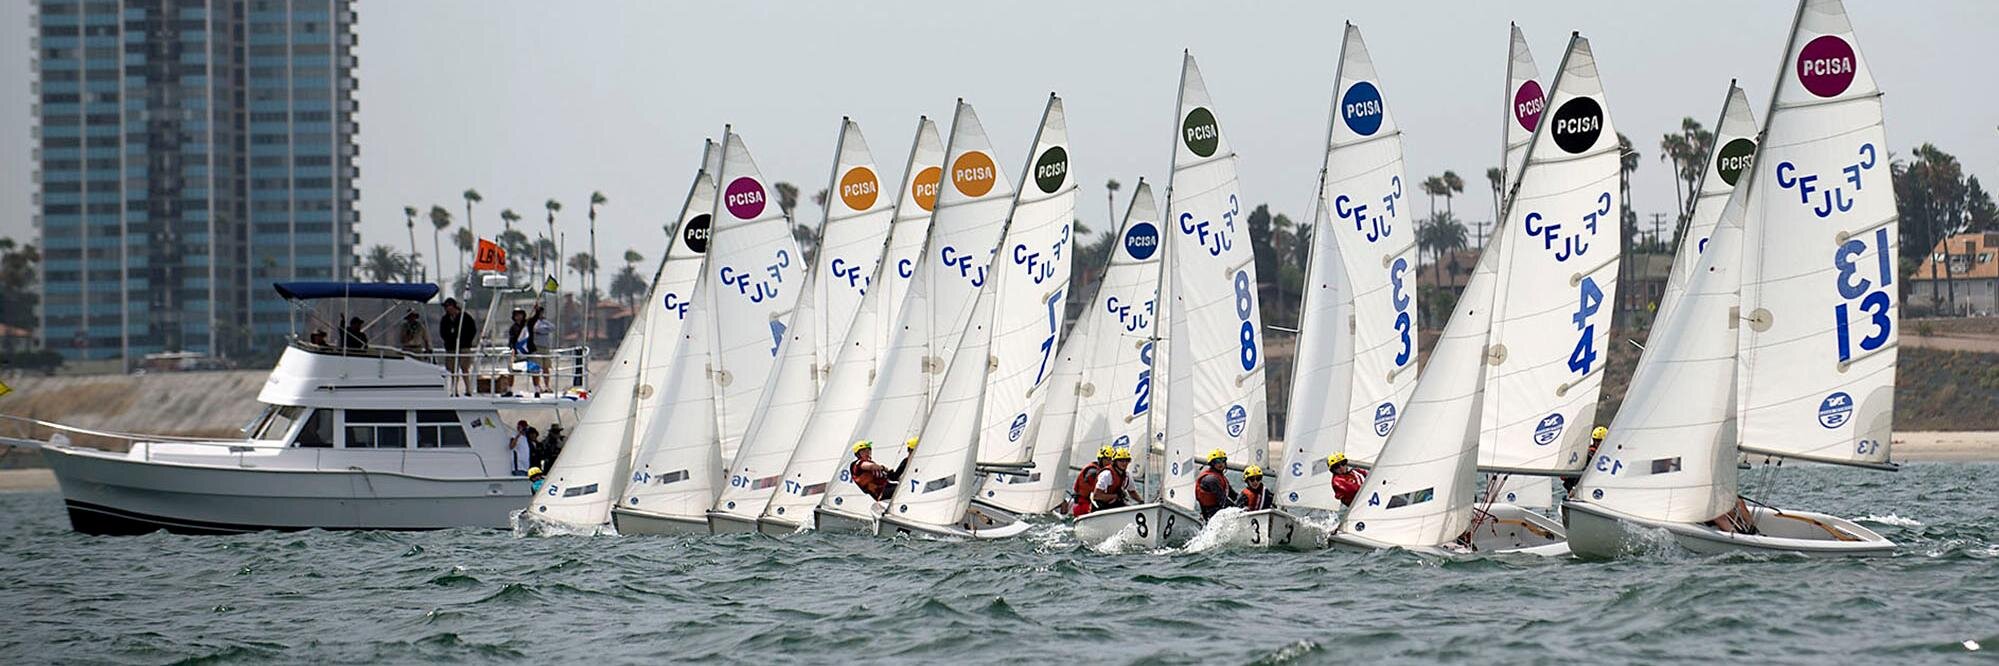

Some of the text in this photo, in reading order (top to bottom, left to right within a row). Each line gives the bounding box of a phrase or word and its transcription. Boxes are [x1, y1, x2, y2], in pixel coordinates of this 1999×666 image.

[1803, 57, 1852, 76] PCISA
[1347, 100, 1381, 118] PCISA
[1518, 97, 1545, 118] PCISA
[1187, 124, 1217, 142] PCISA
[1557, 115, 1599, 134] PCISA
[956, 166, 993, 182] PCISA
[1039, 161, 1065, 179] PCISA
[1721, 154, 1751, 171] PCIS
[729, 191, 763, 207] PCISA
[844, 181, 876, 197] PCISA
[916, 182, 940, 197] PCI
[1776, 161, 1832, 218] CFJ
[1335, 195, 1379, 242] CFJ
[687, 228, 710, 242] PCIS
[1128, 236, 1156, 247] PCISA
[1180, 212, 1221, 256] CFJ
[1525, 212, 1571, 262] CFJ
[941, 246, 985, 287] CFJ
[1014, 244, 1048, 284] CFJ
[720, 267, 764, 303] CFJ
[664, 293, 690, 320] CF
[1107, 297, 1137, 332] CFJ
[1394, 311, 1412, 366] 3
[1835, 291, 1892, 362] 13
[1240, 321, 1257, 371] 8
[1568, 324, 1597, 376] 4
[1135, 512, 1149, 538] 8
[1163, 514, 1175, 540] 8
[1251, 518, 1261, 545] 3
